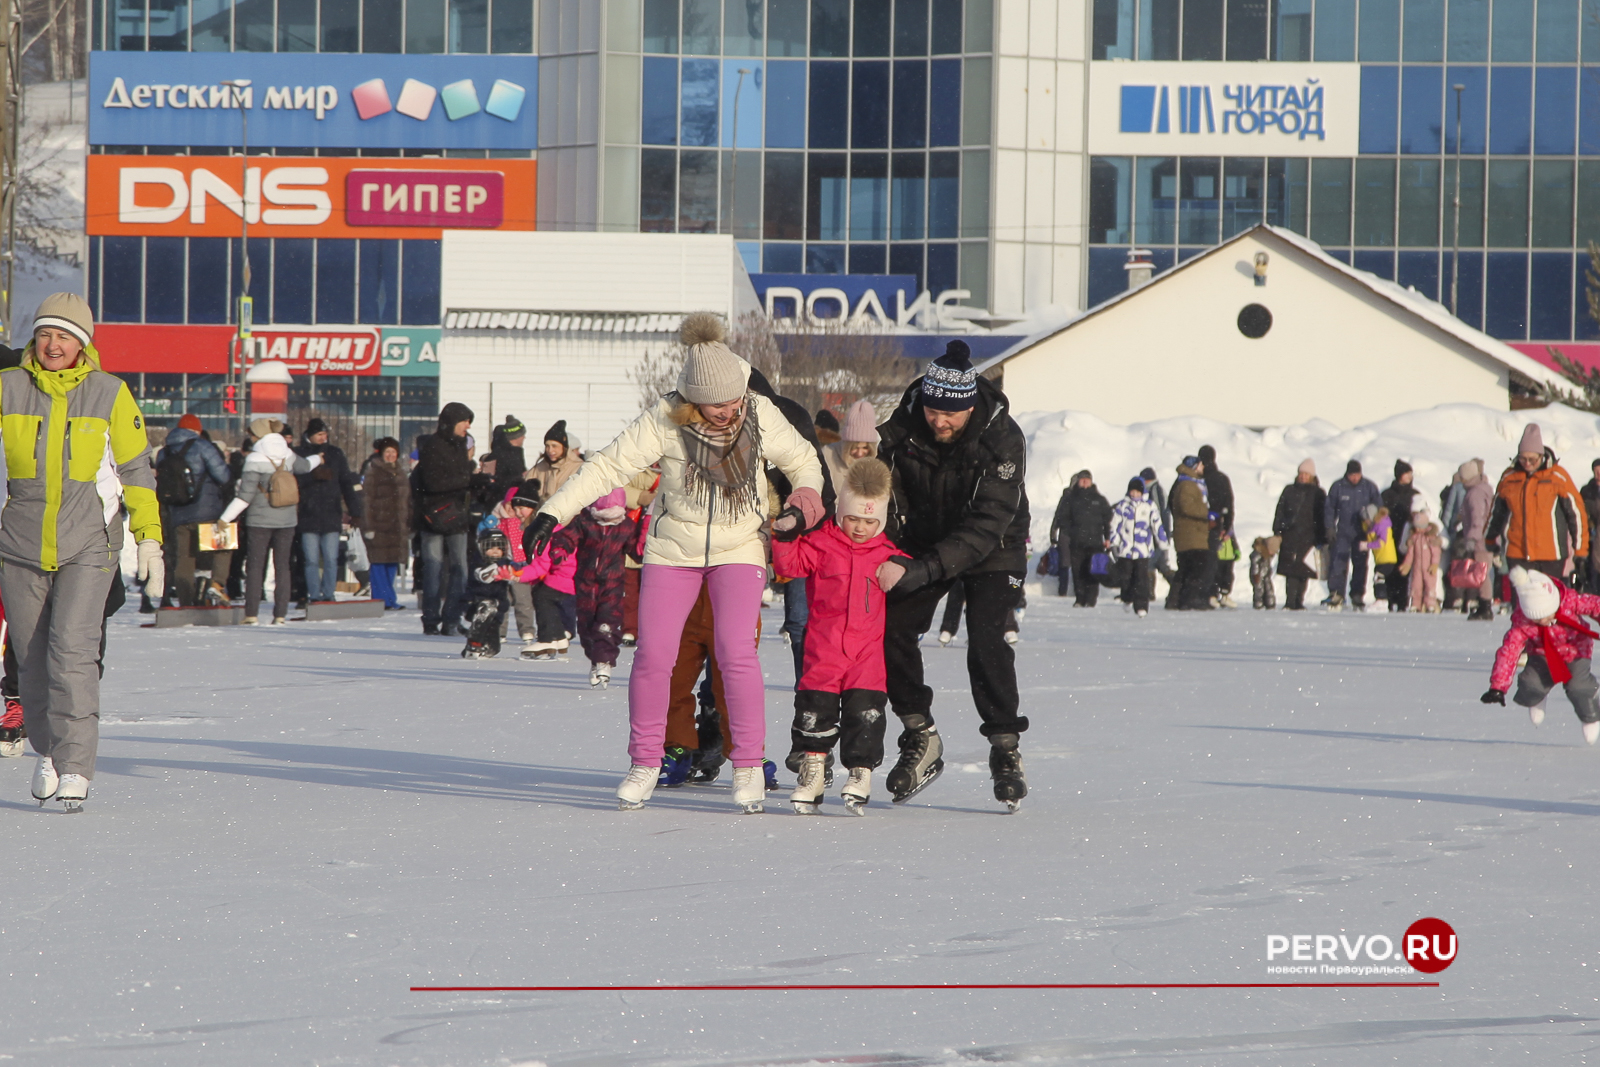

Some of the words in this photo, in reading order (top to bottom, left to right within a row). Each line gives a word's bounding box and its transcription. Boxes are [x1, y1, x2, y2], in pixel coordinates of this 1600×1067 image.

[103, 76, 253, 109] Детский
[263, 84, 338, 120] мир
[1223, 78, 1325, 110] ЧИТАЙ
[1222, 110, 1325, 141] ГОРОД
[119, 166, 332, 225] DNS
[361, 182, 488, 213] ГИПЕР
[765, 286, 972, 332] ПОЛИС
[308, 361, 319, 374] у
[320, 359, 354, 371] дома
